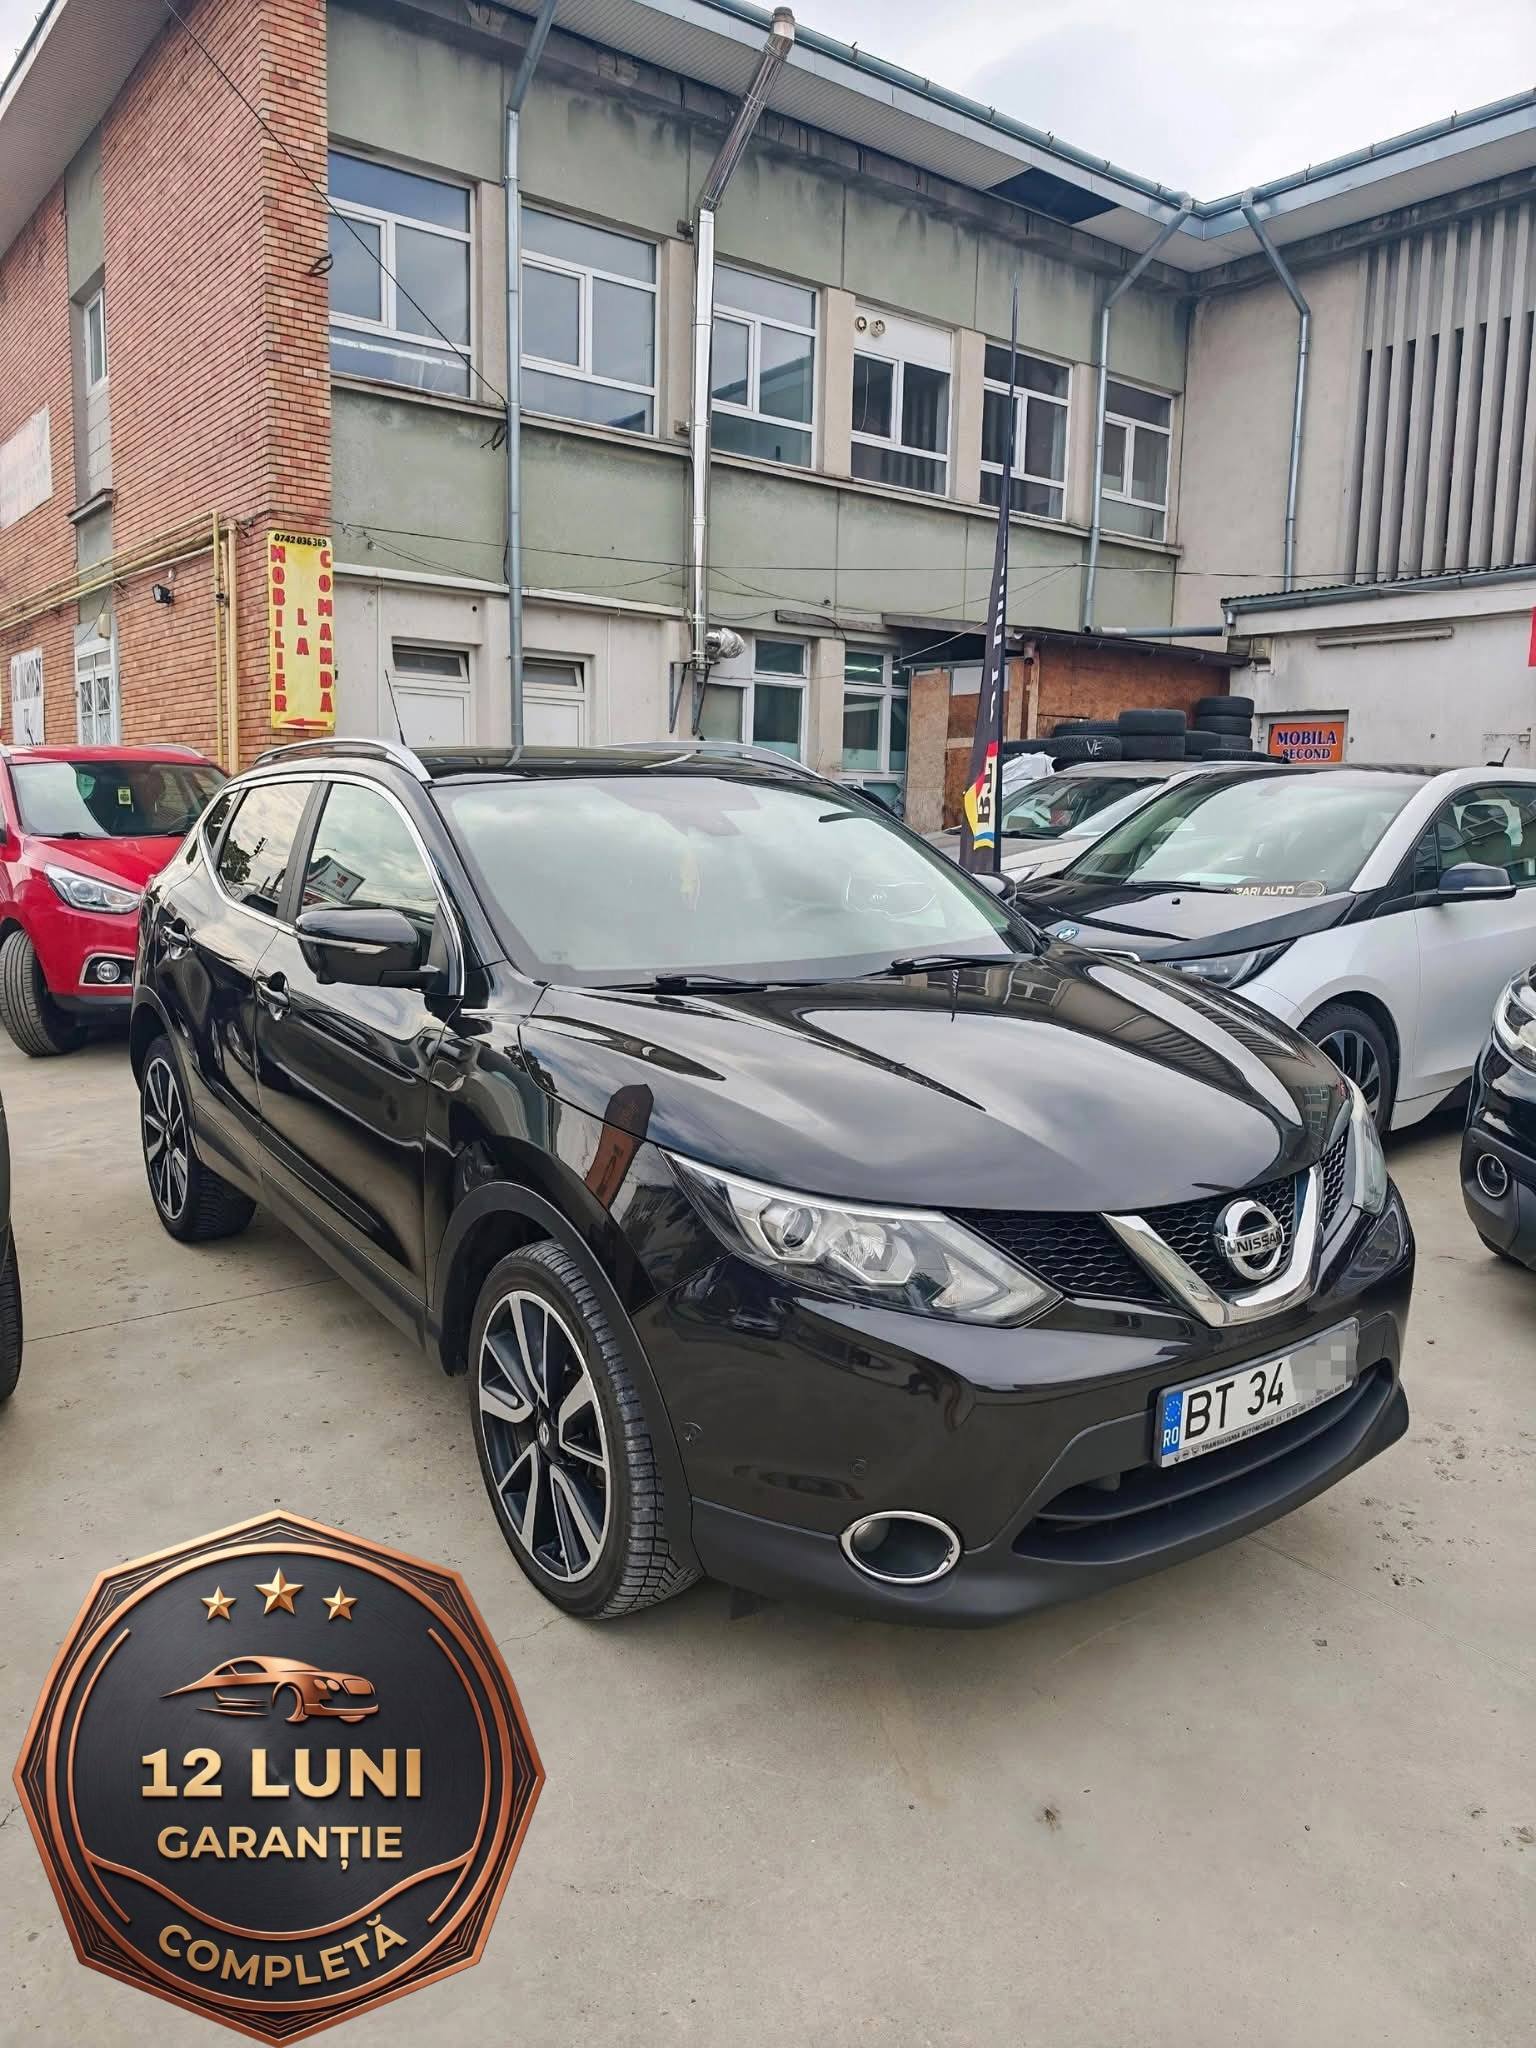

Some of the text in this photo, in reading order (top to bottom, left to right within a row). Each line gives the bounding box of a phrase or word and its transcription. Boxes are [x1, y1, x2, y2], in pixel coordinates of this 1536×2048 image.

[270, 544, 287, 712] MOBILIER
[296, 608, 309, 655] LA
[1277, 731, 1337, 745] MOBILA
[1282, 749, 1331, 760] SECOND
[1262, 886, 1295, 896] AUTO
[1236, 1231, 1281, 1253] NISSAN
[1185, 1381, 1235, 1441] BT
[1247, 1363, 1283, 1416] 34
[1163, 1427, 1179, 1449] RO
